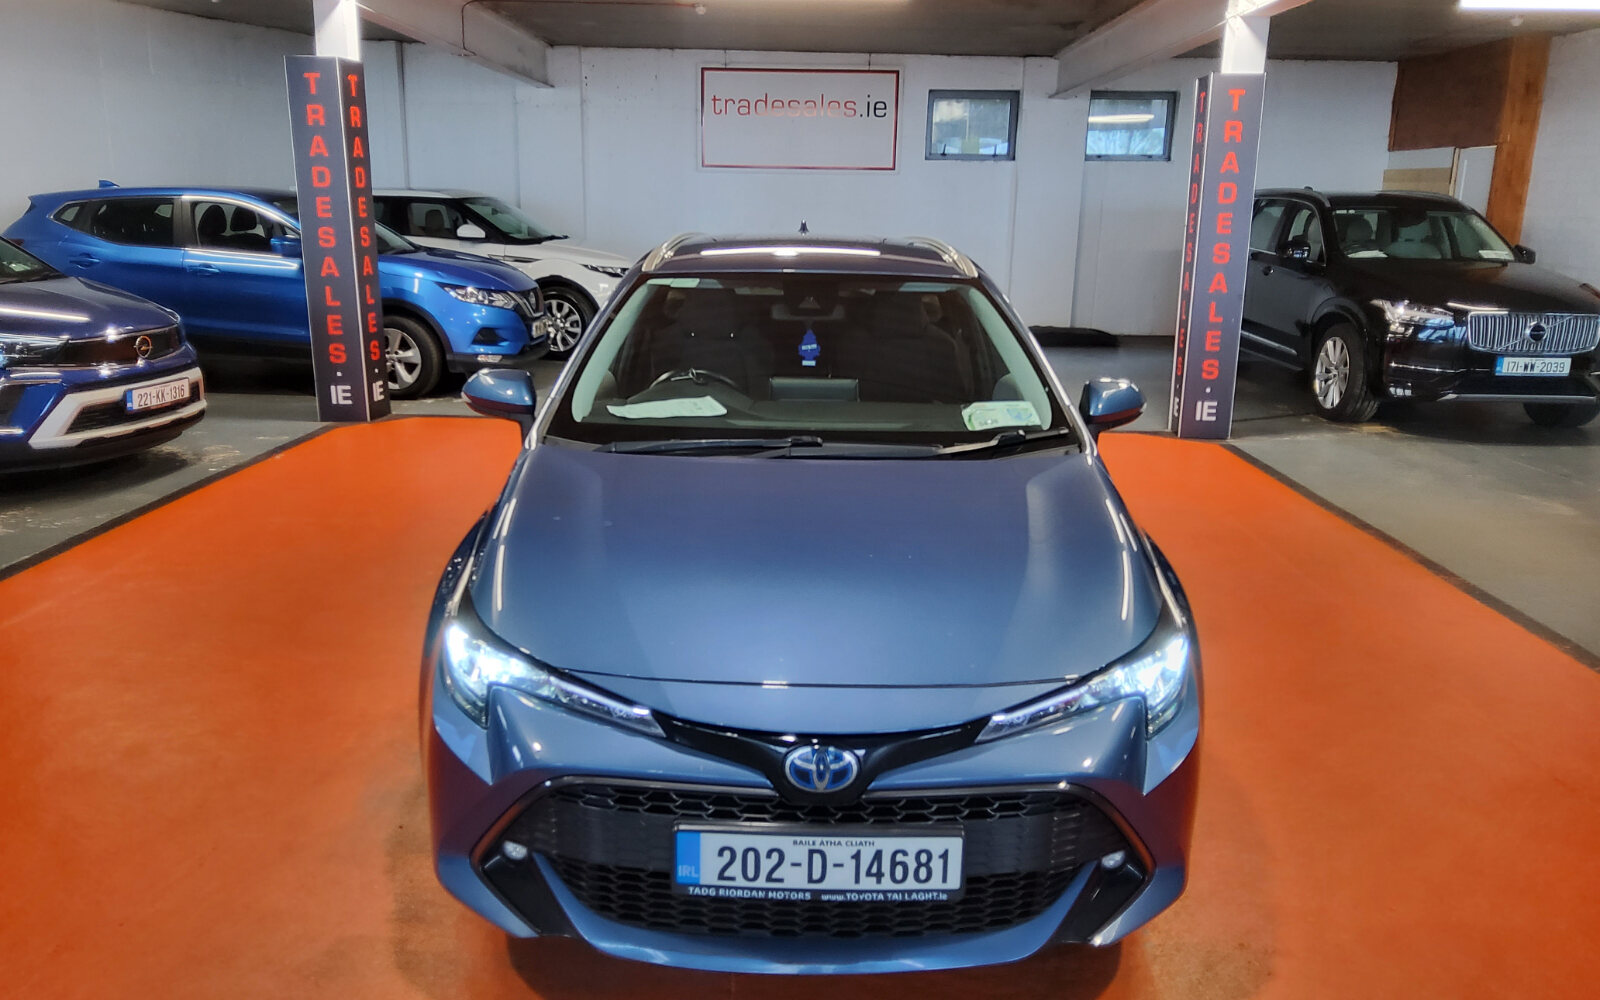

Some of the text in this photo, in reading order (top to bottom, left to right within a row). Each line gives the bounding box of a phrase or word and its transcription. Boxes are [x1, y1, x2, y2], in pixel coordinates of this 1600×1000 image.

[711, 92, 887, 118] tradesales.ie
[1506, 361, 1566, 373] 171-WW-2039
[137, 384, 185, 407] 221-KK-1316
[792, 839, 816, 847] BAILE
[845, 840, 875, 848] CLIATH
[678, 864, 699, 878] IRL
[716, 845, 950, 886] 202-D-14681
[687, 886, 812, 901] TADG RIORDAN MOTORS
